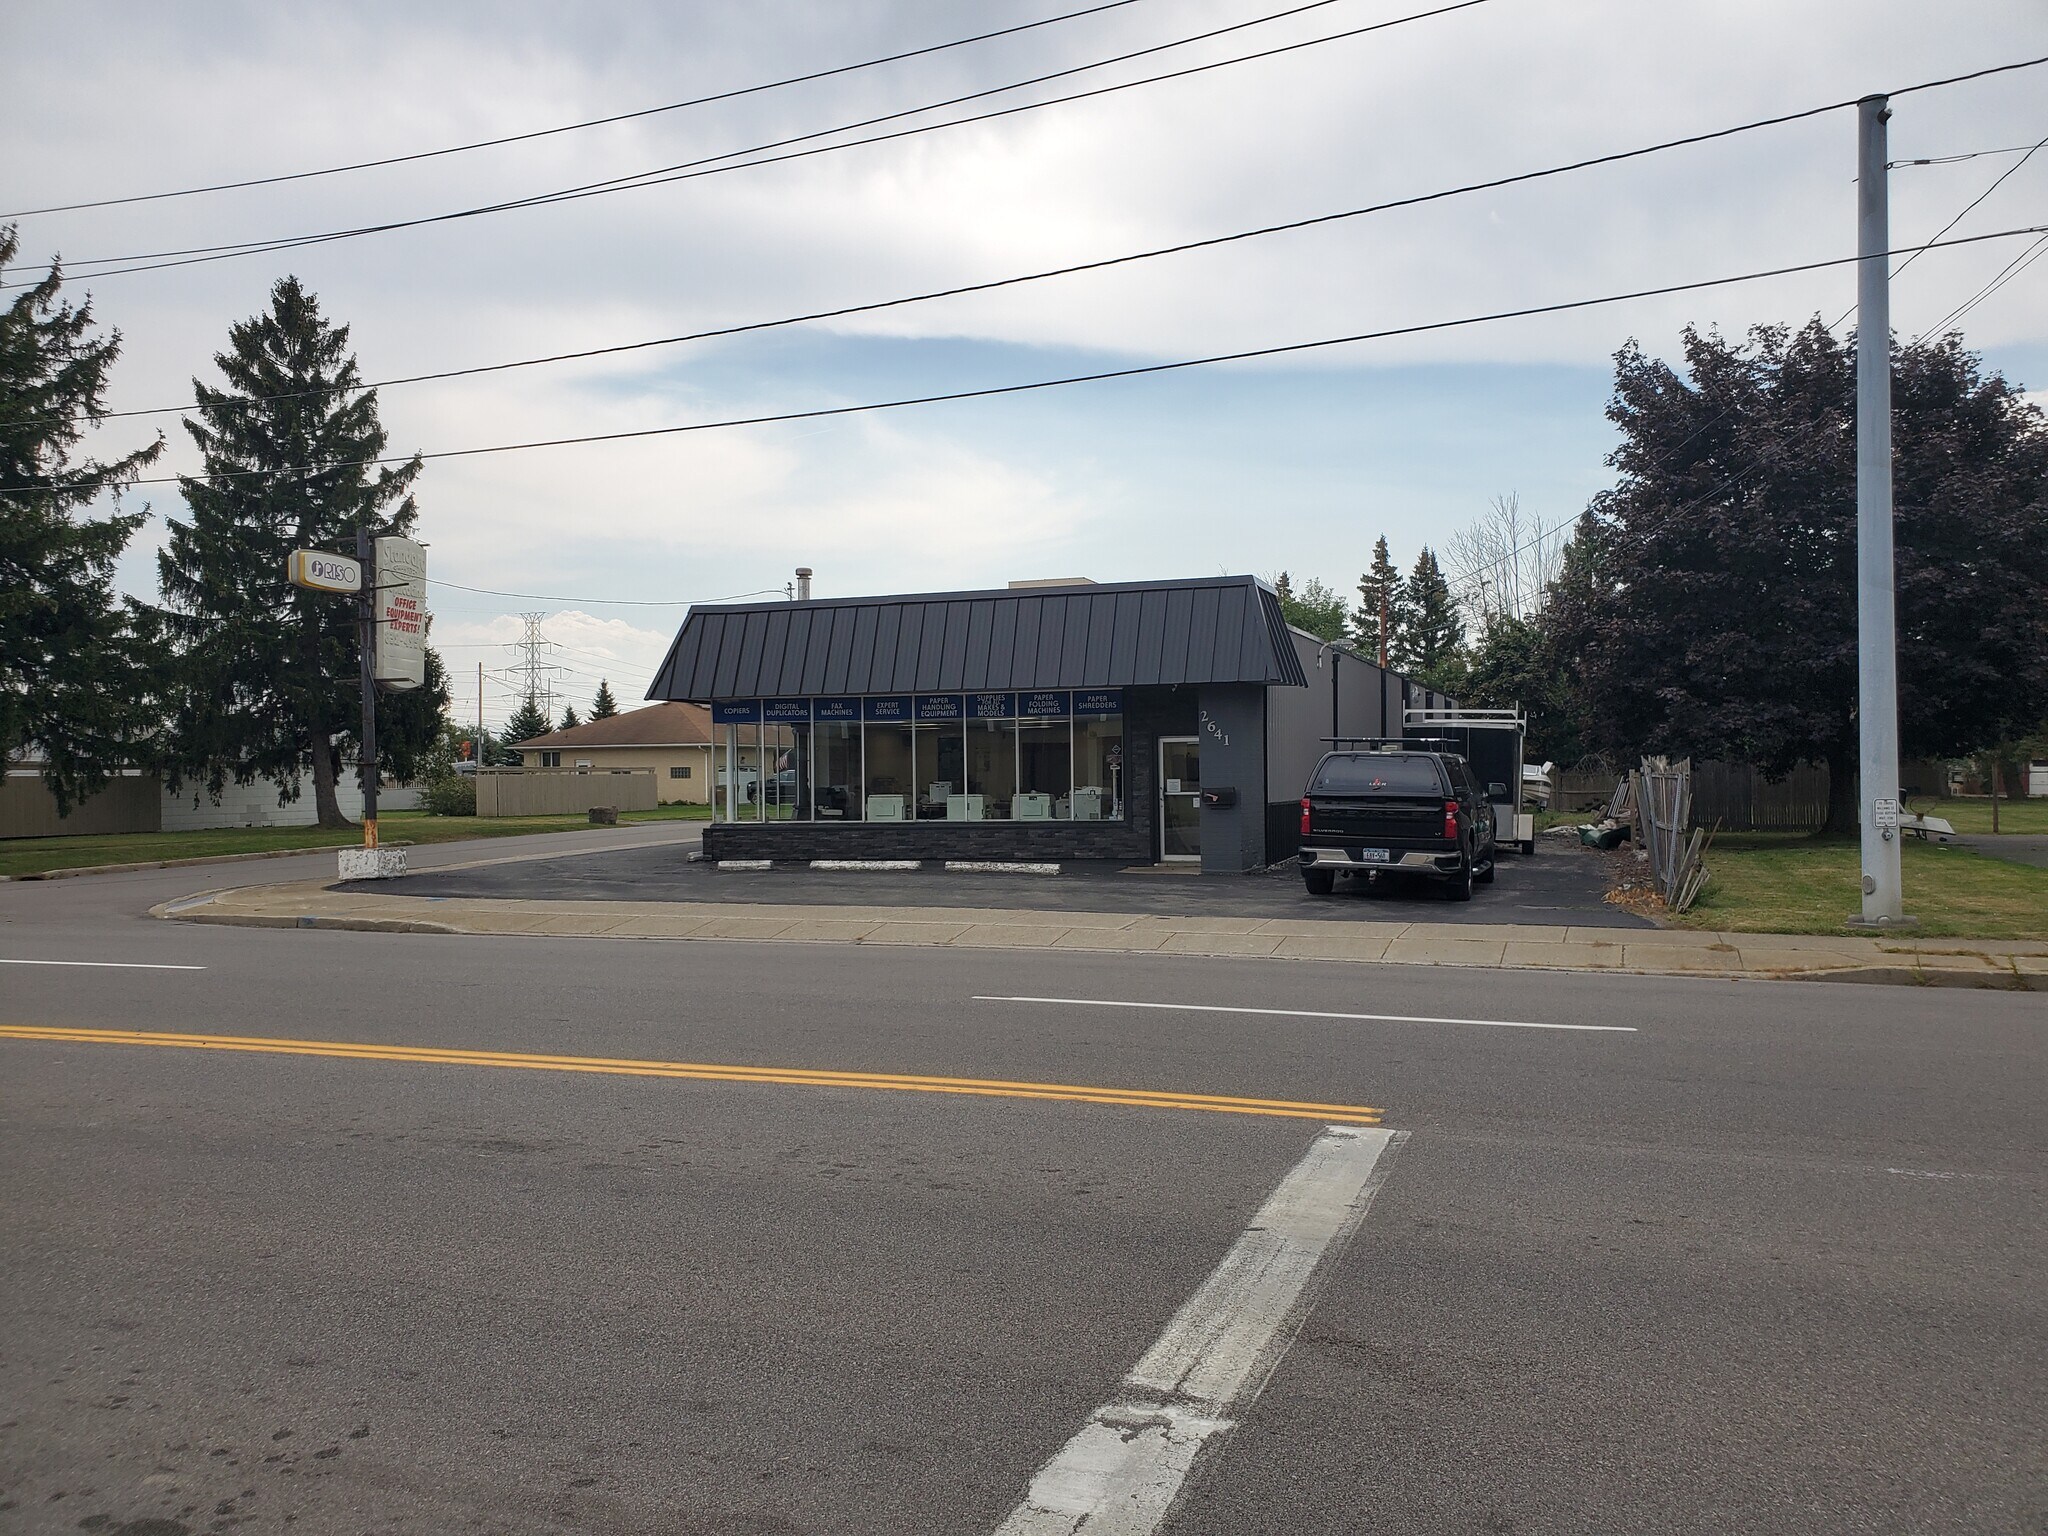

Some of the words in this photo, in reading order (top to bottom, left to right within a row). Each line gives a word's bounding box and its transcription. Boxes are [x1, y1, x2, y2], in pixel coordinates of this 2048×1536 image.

[323, 562, 356, 583] RISO
[394, 596, 417, 610] OFFICE
[386, 606, 423, 623] EQUIPMENT
[389, 620, 420, 634] EXPERTS!
[976, 694, 1006, 702] SUPPLIES
[921, 703, 957, 711] HANDLING
[1028, 700, 1059, 708] FOLDING
[1078, 701, 1117, 710] SHREDDERS
[723, 707, 750, 715] COPIERS
[821, 708, 853, 716] MACHINES
[875, 708, 900, 716] SERVICE
[1027, 706, 1061, 714] MACHINES
[1200, 710, 1230, 746] 2641
